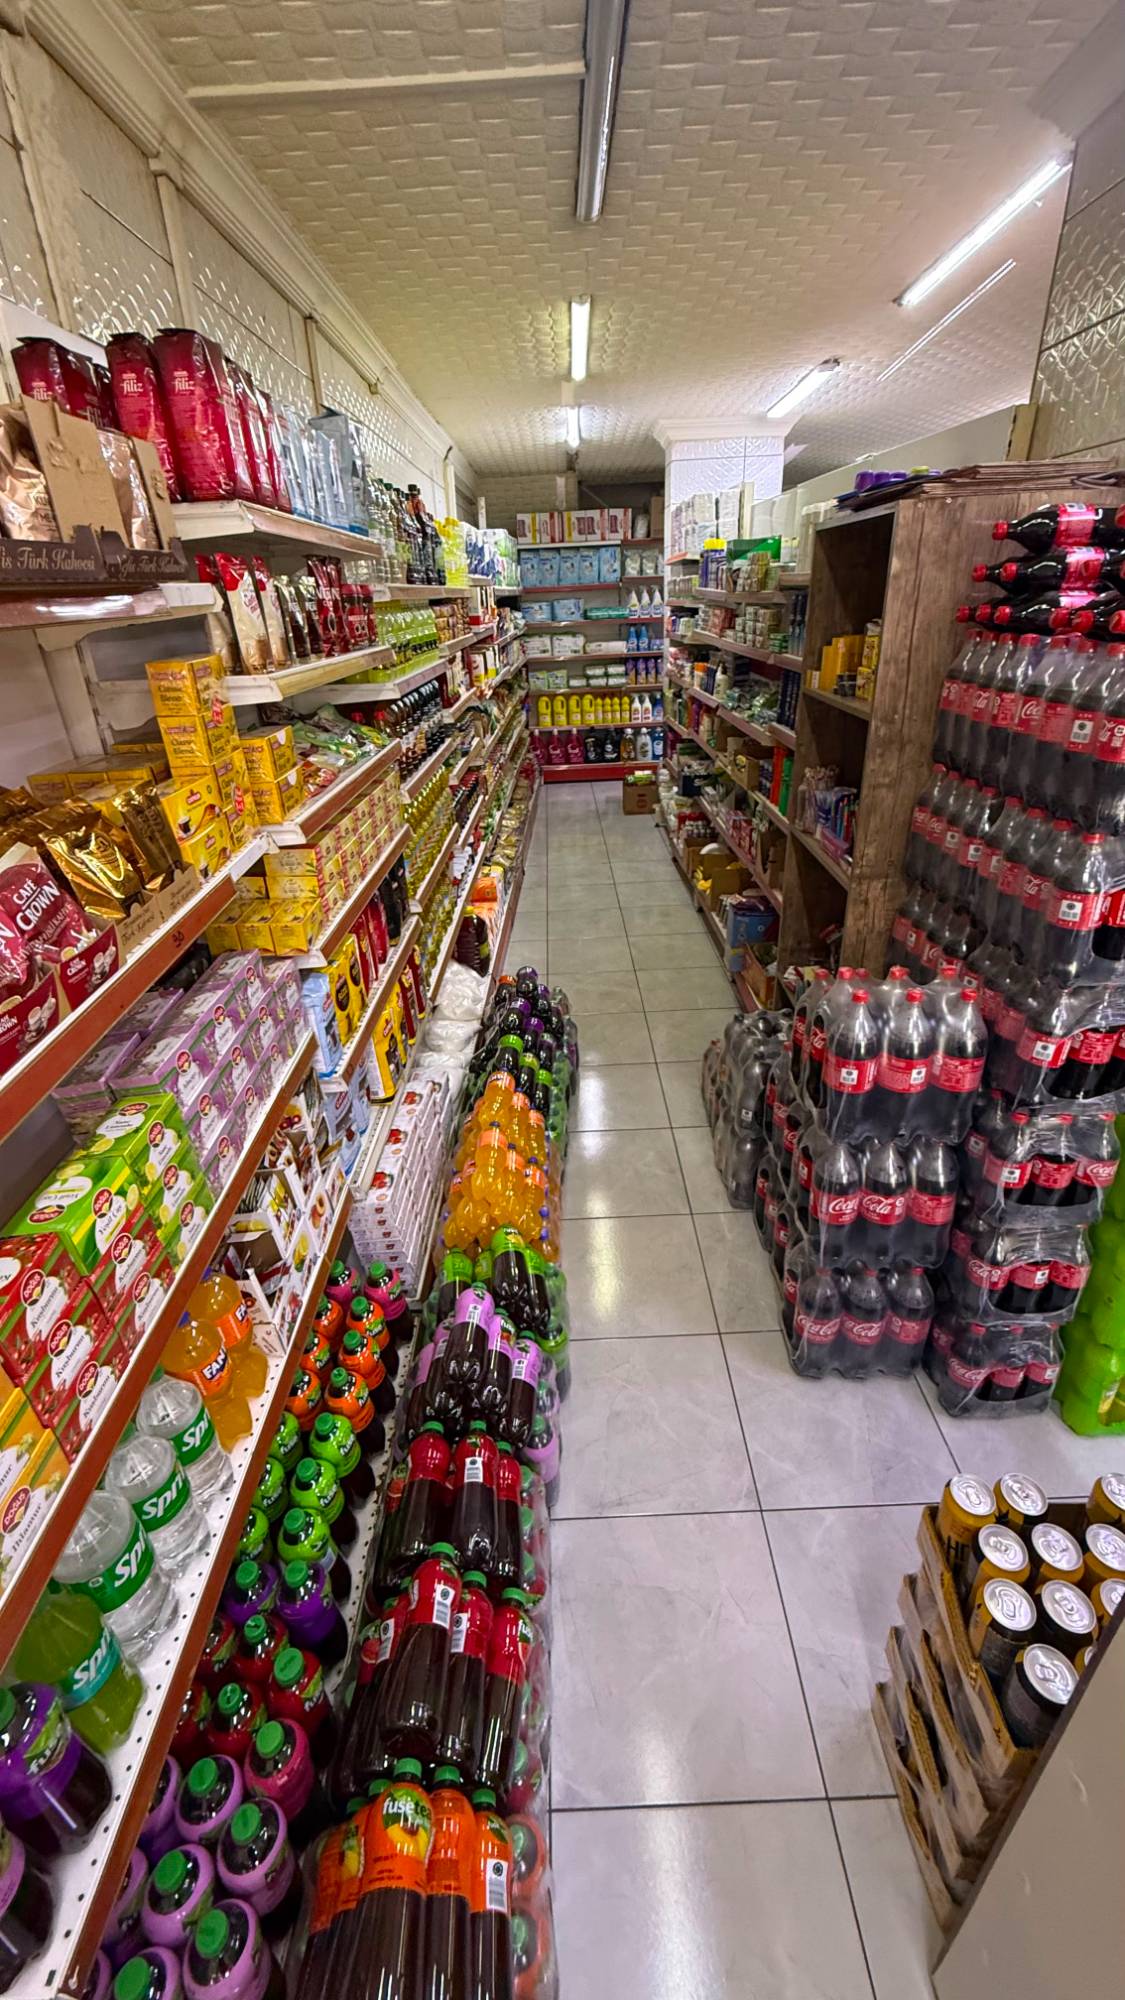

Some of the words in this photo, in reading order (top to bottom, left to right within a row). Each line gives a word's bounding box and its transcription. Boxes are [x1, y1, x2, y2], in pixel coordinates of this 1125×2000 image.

[120, 379, 144, 394] filiz
[172, 376, 196, 393] filiz
[0, 546, 13, 570] is
[17, 546, 49, 570] Türk
[52, 549, 96, 571] Kahvesi
[12, 878, 38, 905] CAFÉ
[16, 880, 60, 931] CROWN
[0, 1016, 18, 1034] ROWN
[201, 1344, 228, 1380] FAN
